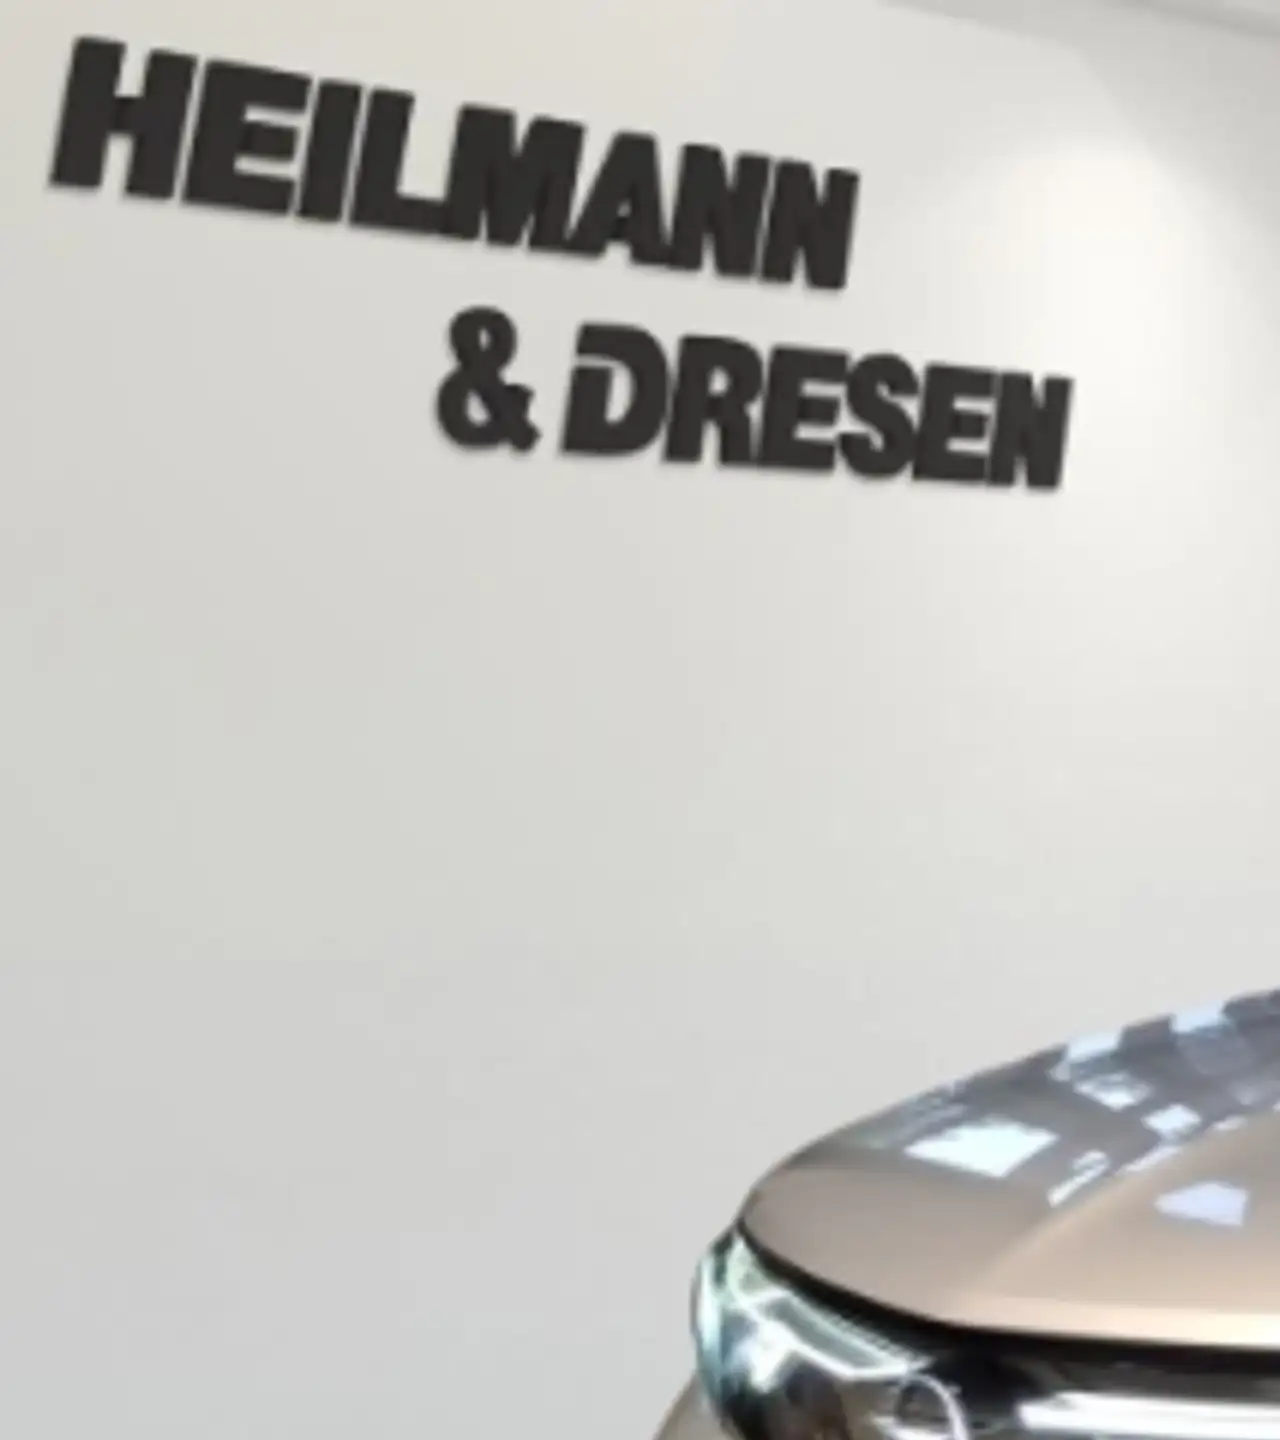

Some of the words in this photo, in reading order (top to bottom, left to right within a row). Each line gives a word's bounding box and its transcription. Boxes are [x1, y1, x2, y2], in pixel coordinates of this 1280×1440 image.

[50, 36, 860, 291] HEILMANN
[436, 306, 540, 452] &
[561, 322, 1073, 491] DRESEN
